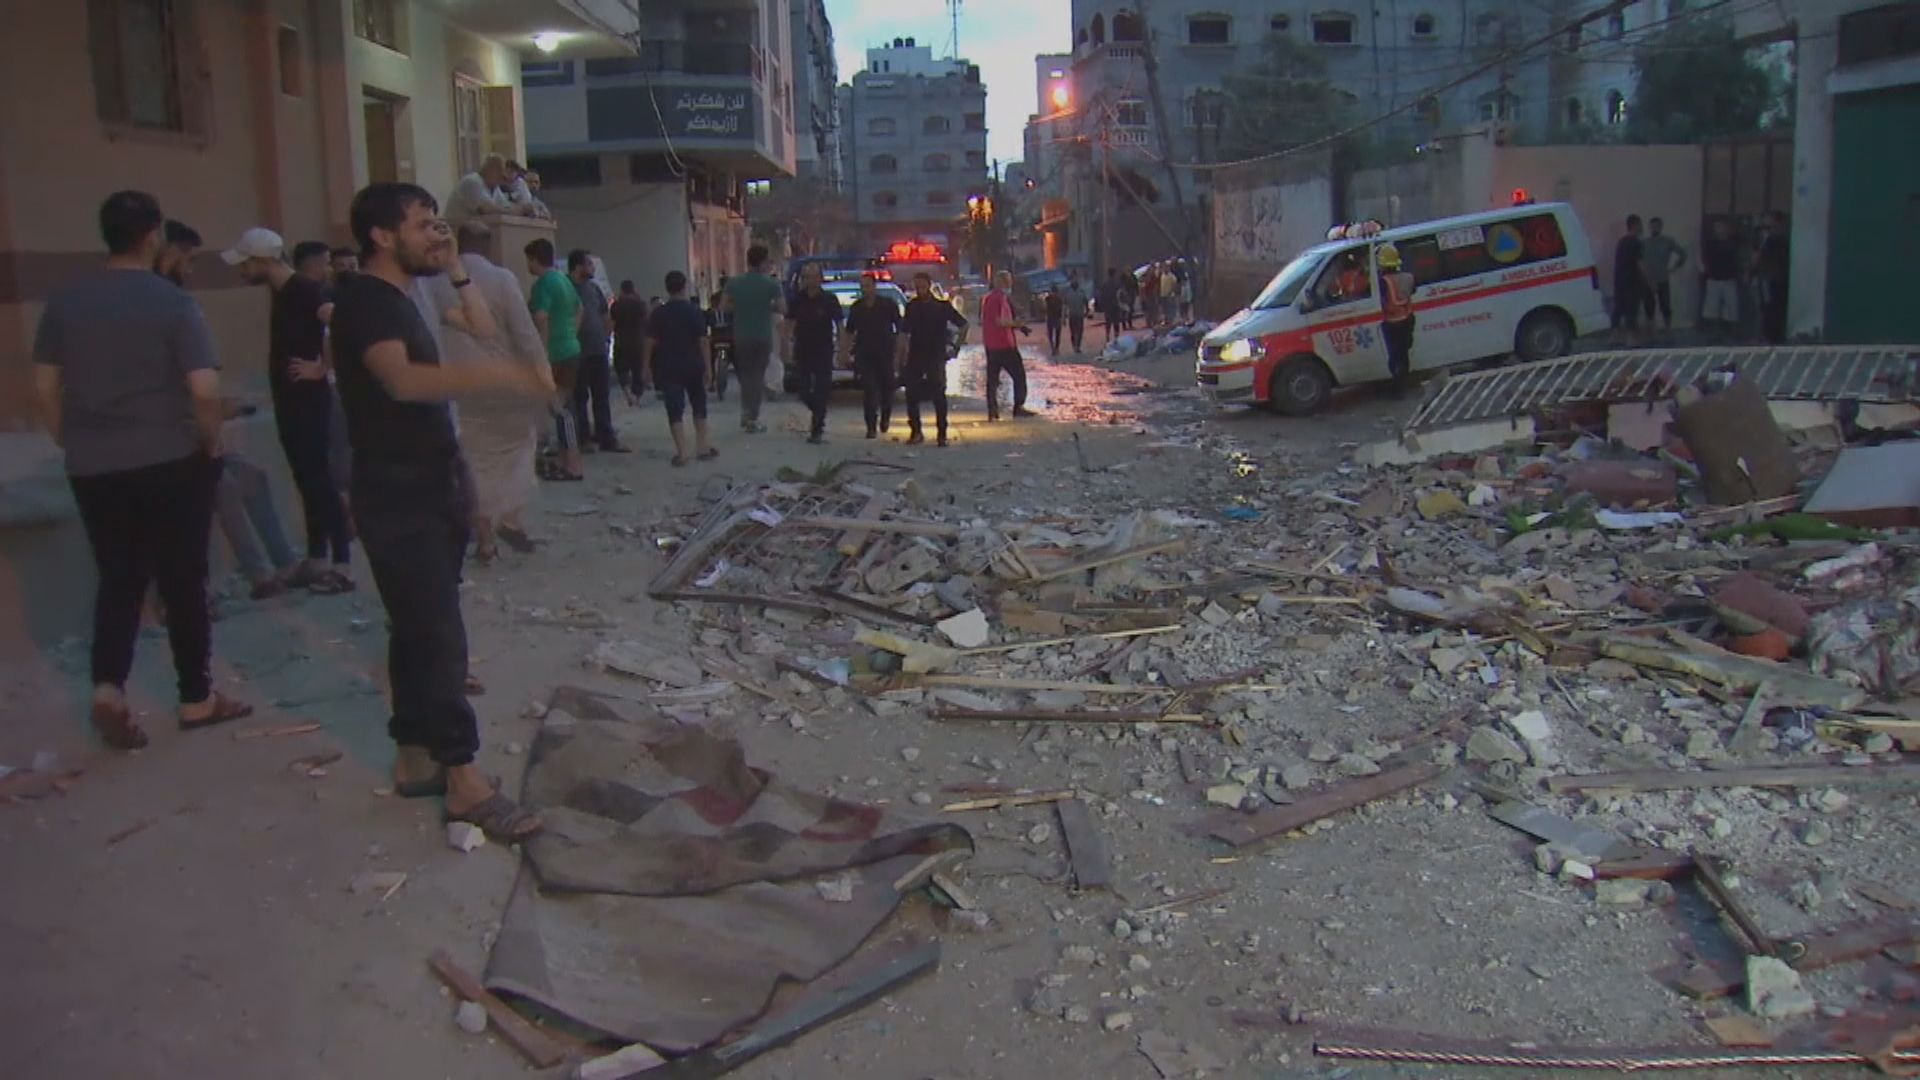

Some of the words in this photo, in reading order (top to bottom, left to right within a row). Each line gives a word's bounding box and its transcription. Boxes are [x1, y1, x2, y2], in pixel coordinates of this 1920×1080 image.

[676, 92, 726, 112] شكرتم
[1501, 260, 1569, 282] AMBULANCE
[1328, 327, 1353, 345] 102
